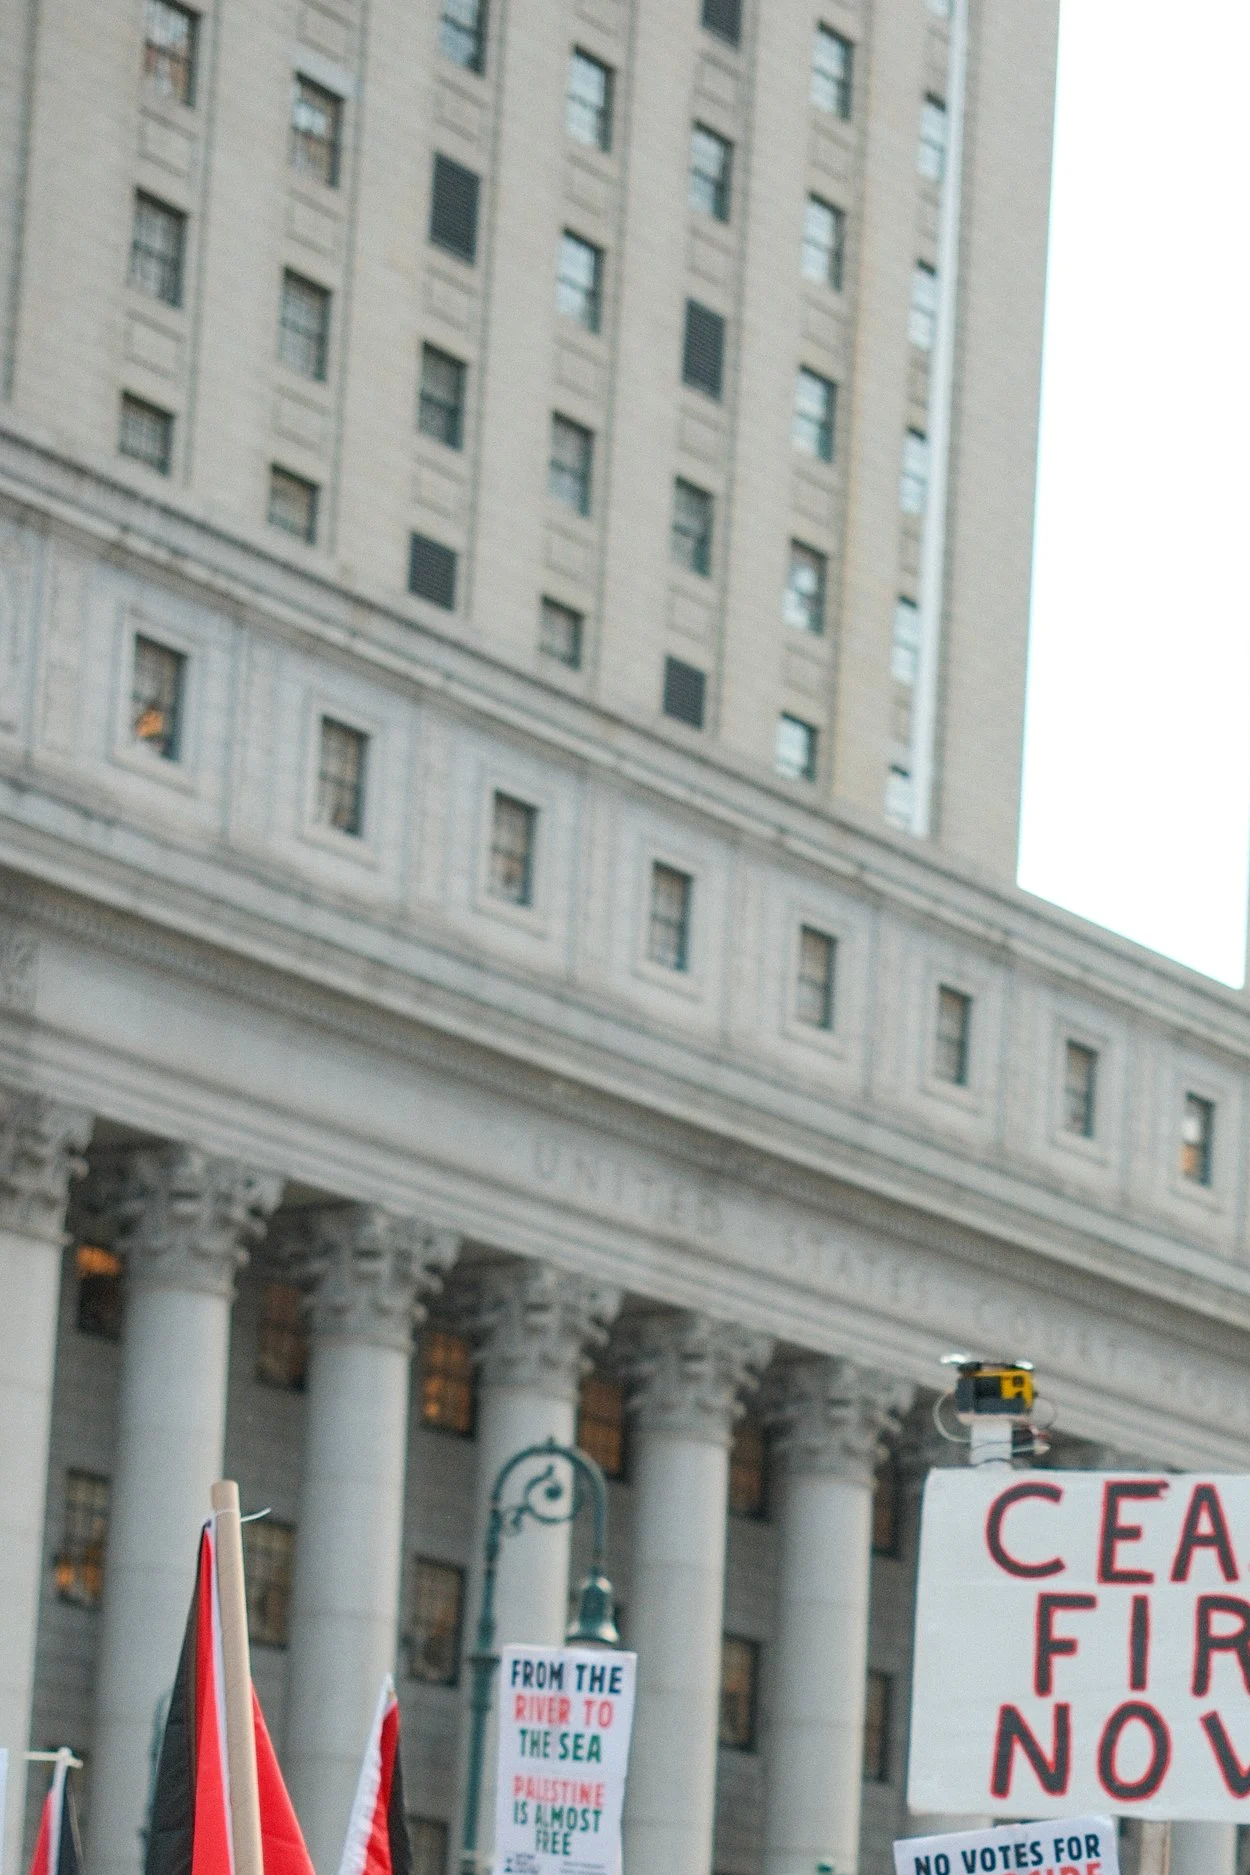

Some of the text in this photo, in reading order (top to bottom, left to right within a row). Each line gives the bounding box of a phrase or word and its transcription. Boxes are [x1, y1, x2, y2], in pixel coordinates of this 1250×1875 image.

[511, 1659, 623, 1695] FROM THE
[514, 1694, 615, 1729] RIVER TO
[518, 1728, 602, 1764] THE SEA
[513, 1800, 601, 1833] IS ALMOST
[535, 1831, 572, 1856] FREE
[961, 1841, 1043, 1875] VOTES
[1053, 1833, 1101, 1863] FOR
